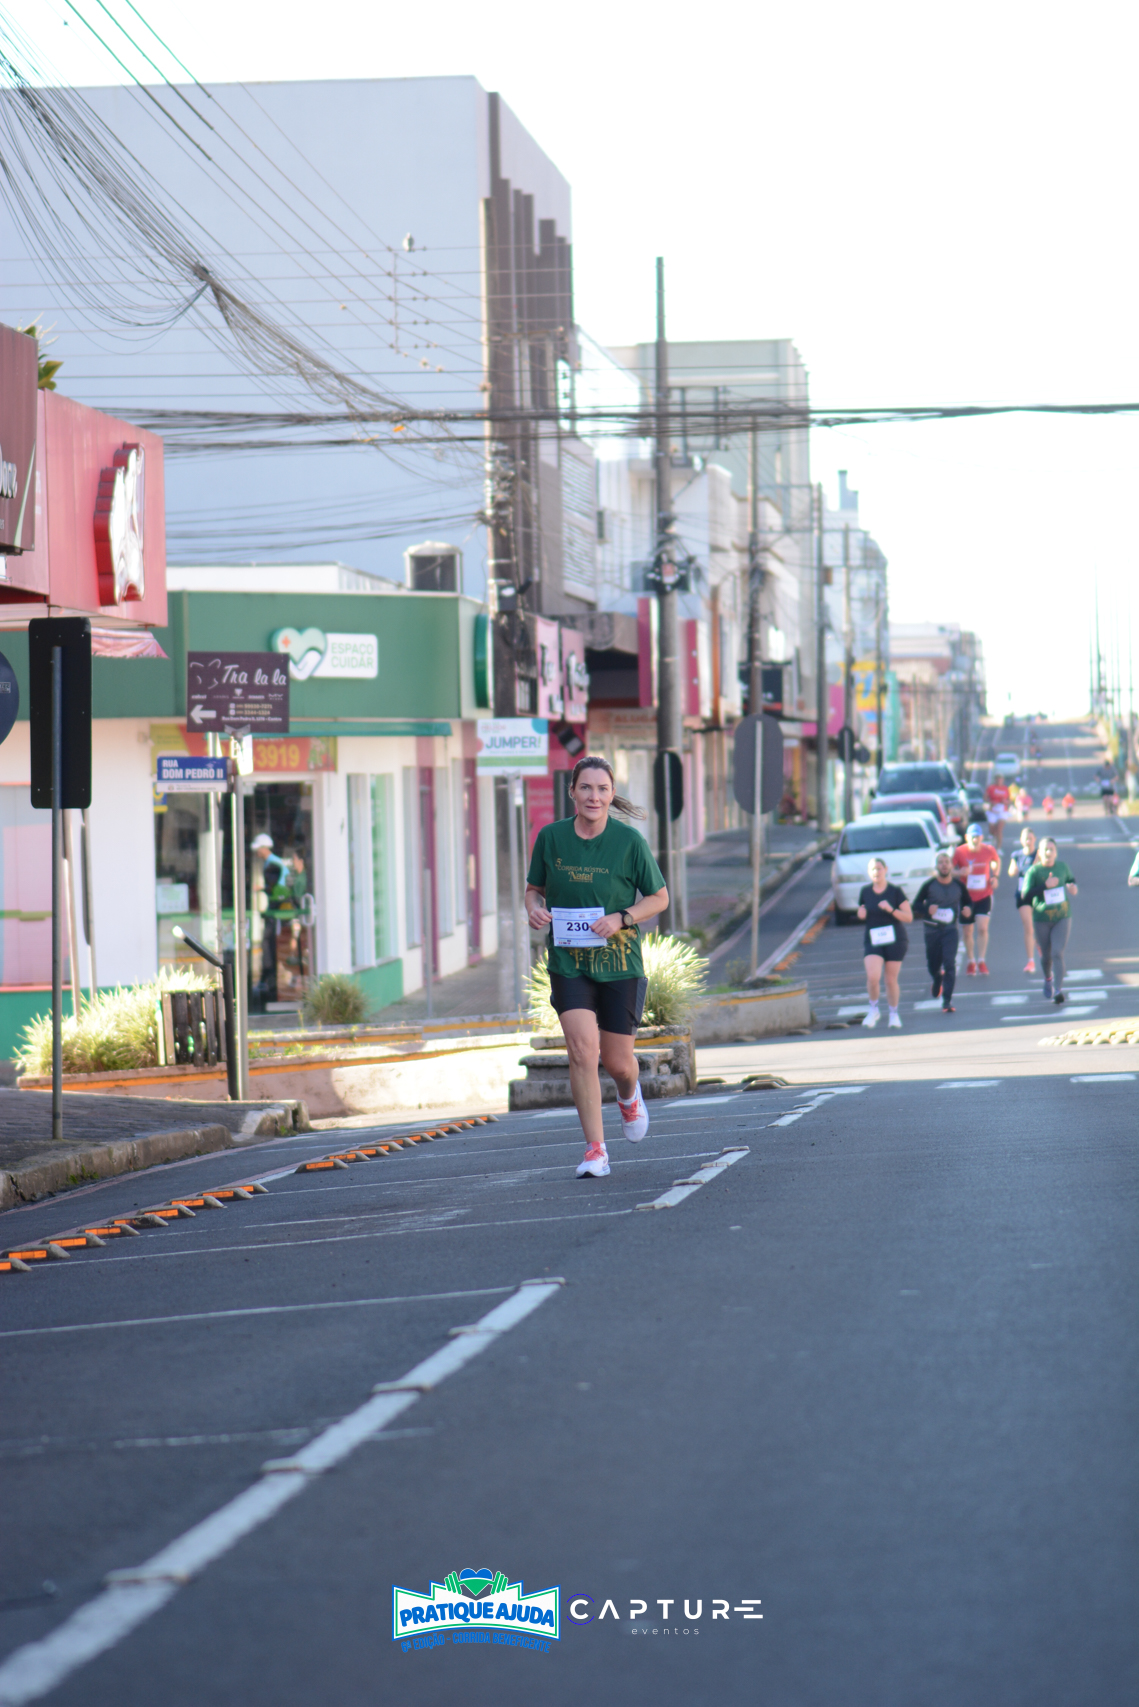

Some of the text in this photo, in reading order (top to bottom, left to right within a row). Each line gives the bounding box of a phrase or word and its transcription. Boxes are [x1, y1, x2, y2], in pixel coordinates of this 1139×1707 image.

[331, 643, 374, 655] ESPAÇO
[331, 656, 374, 669] CUIDAR
[222, 664, 287, 685] Tra la la
[485, 735, 541, 749] JUMPER!
[257, 744, 299, 768] 3919
[162, 759, 179, 768] RUA
[162, 768, 224, 779] DOM PEDRO II
[584, 865, 609, 874] RÚSTICA
[568, 871, 594, 880] Natal
[566, 921, 590, 932] 230
